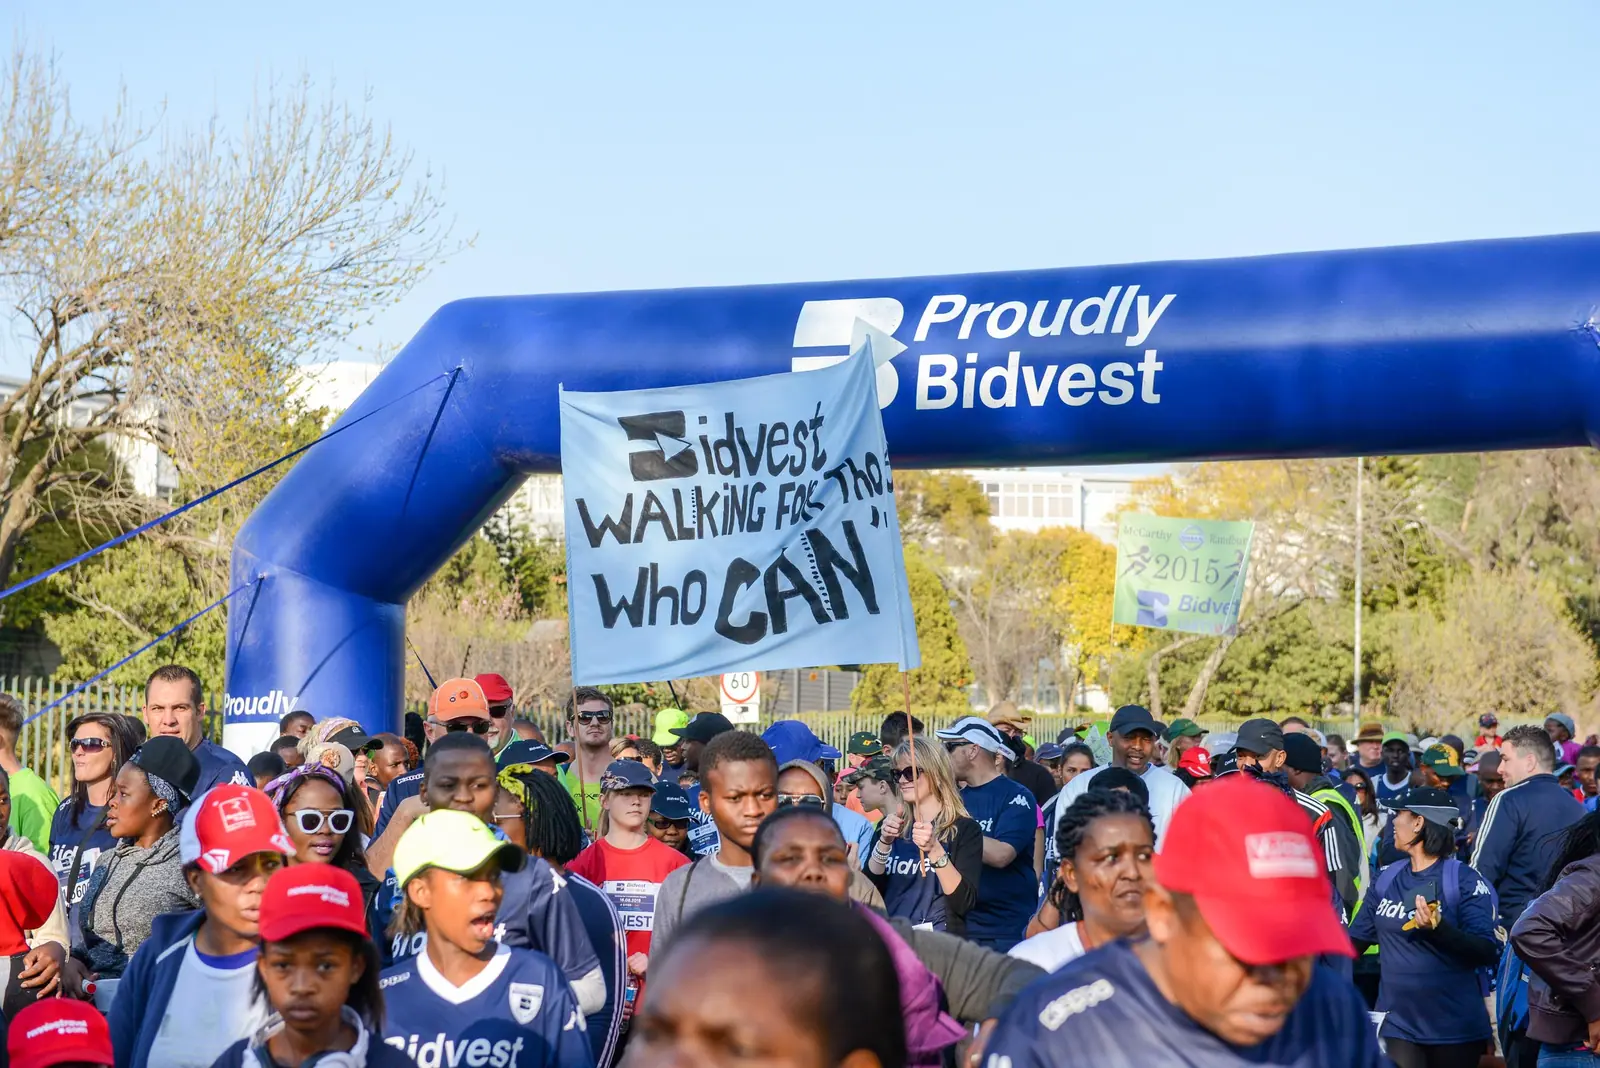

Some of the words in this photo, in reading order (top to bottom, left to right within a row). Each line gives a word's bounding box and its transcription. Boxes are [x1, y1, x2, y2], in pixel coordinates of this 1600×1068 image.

[913, 284, 1177, 347] Proudly
[915, 349, 1164, 411] Bidvest
[617, 401, 827, 482] Bidvest
[1122, 525, 1173, 542] McCarthy
[1209, 533, 1248, 547] Randbur
[1153, 553, 1220, 585] 2015
[731, 672, 749, 689] 60
[223, 689, 299, 720] Proudly
[884, 855, 938, 876] Bidve
[622, 915, 652, 927] EST
